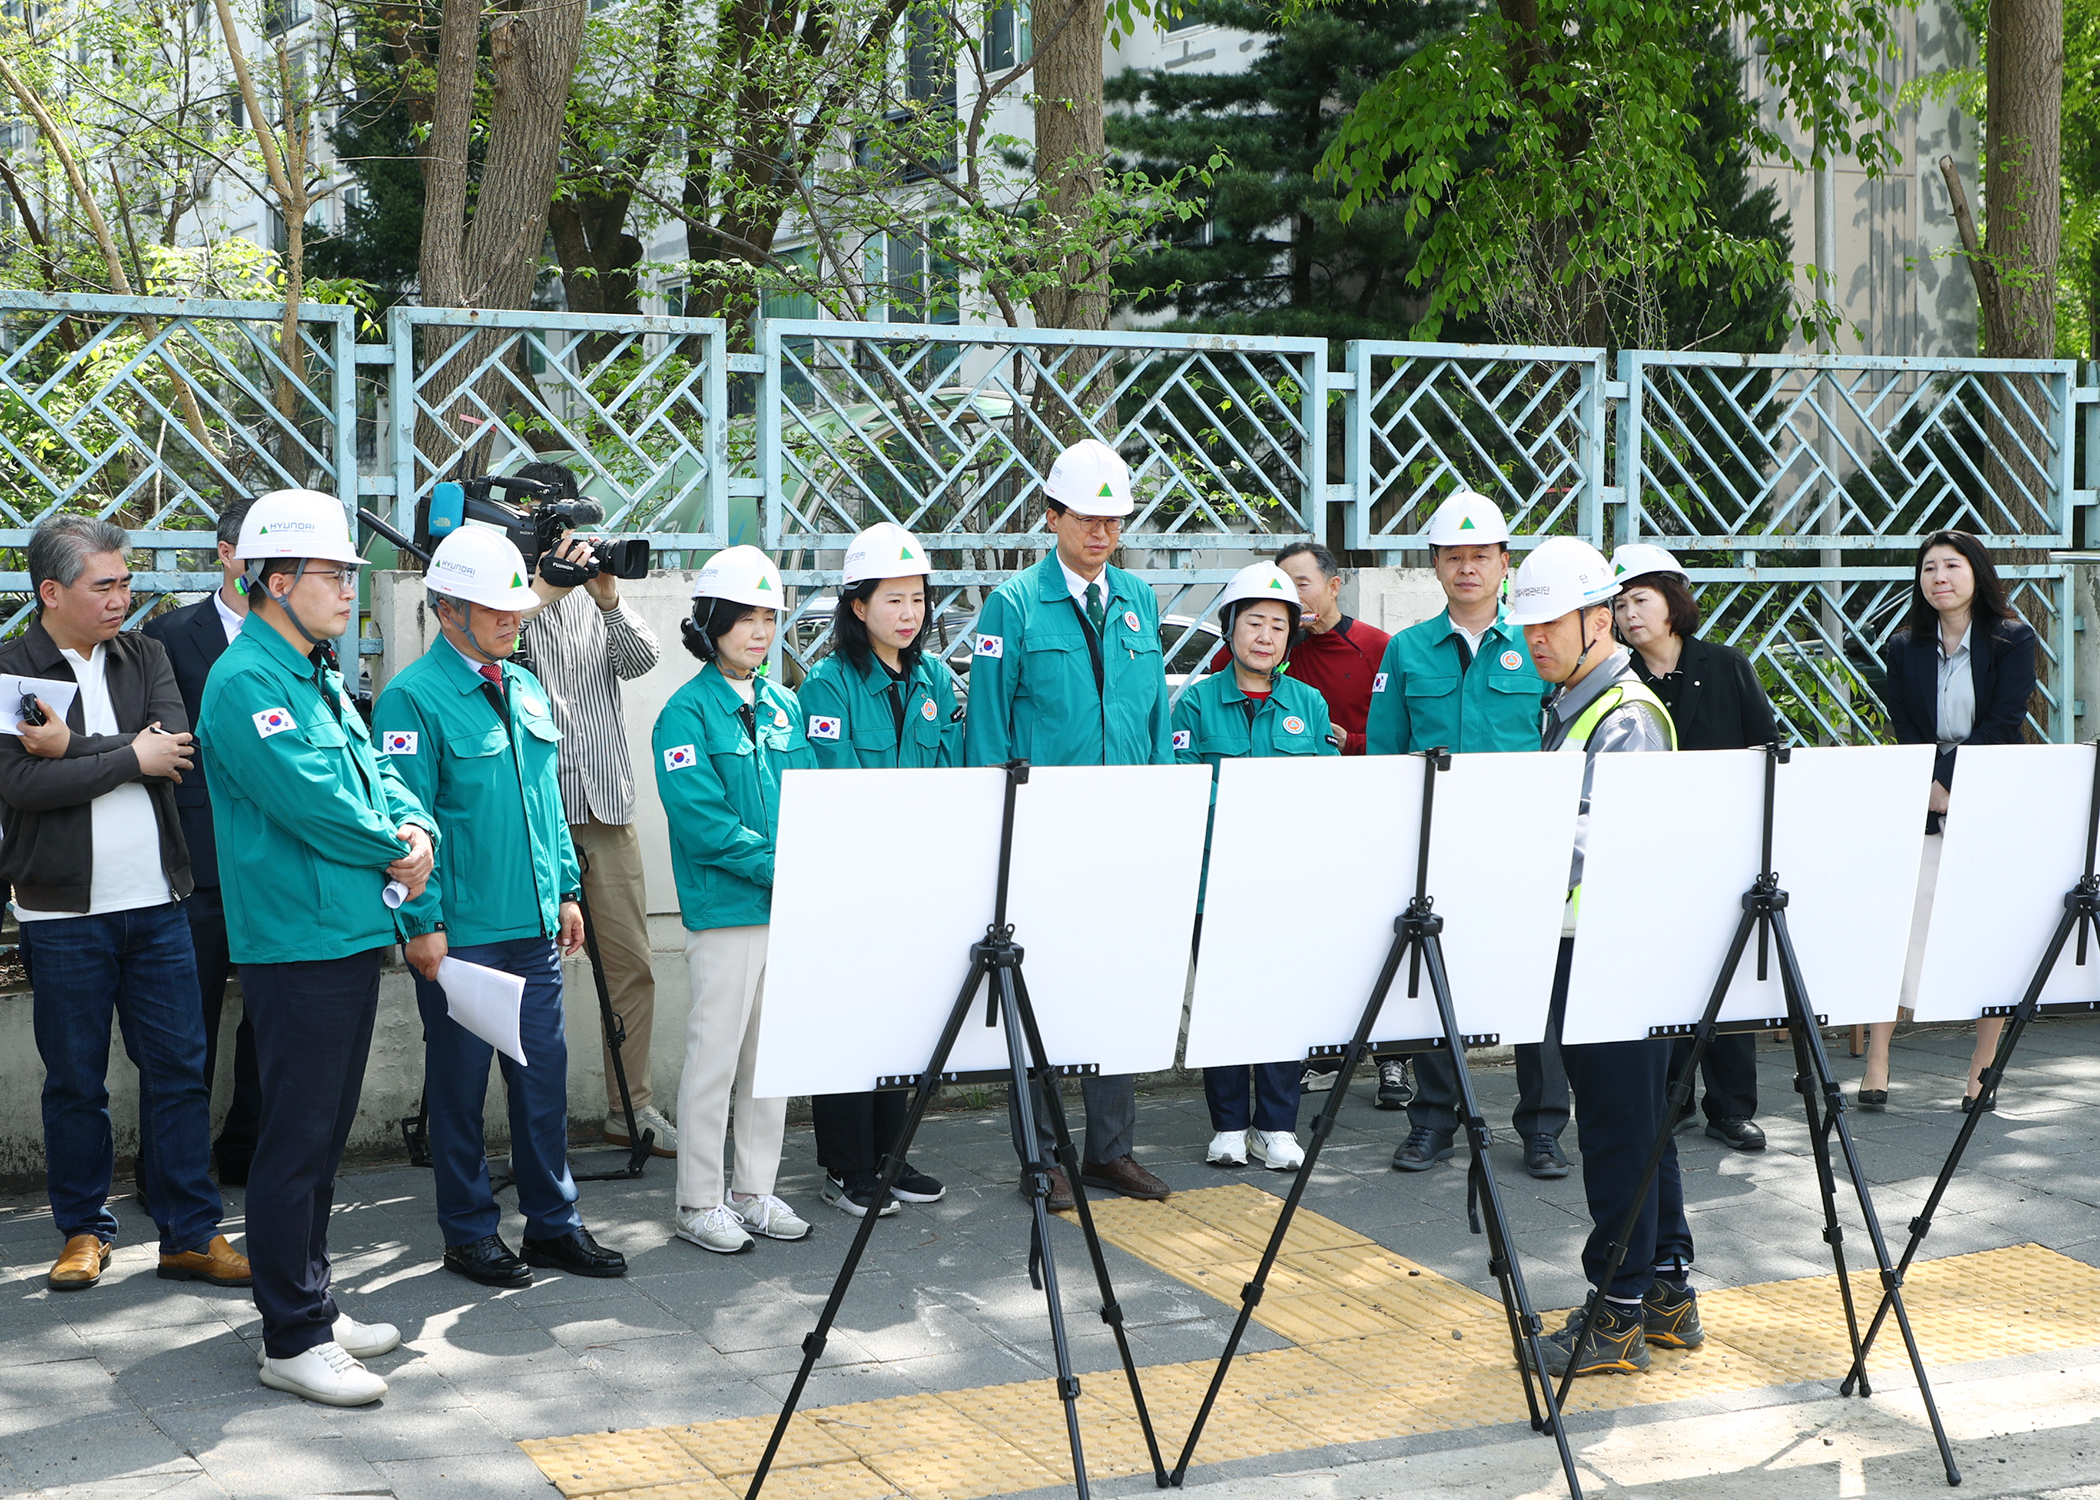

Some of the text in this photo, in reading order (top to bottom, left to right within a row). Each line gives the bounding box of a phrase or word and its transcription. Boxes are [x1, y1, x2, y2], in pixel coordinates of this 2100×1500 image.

[270, 522, 315, 531] HYUNDAI
[442, 560, 476, 576] HYUNDAI
[552, 562, 574, 571] FUJINON
